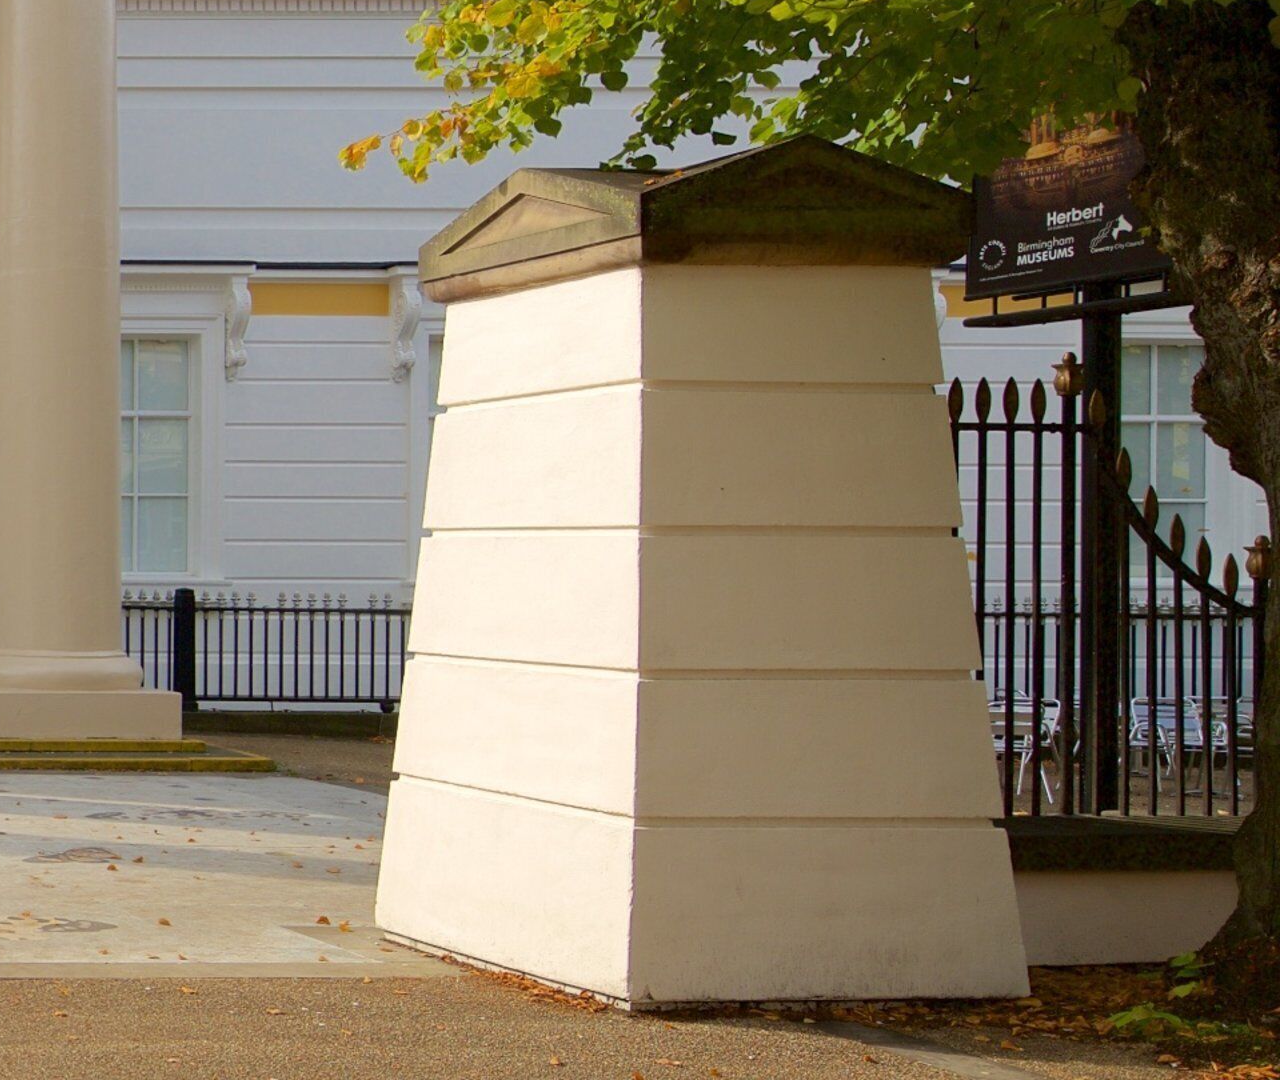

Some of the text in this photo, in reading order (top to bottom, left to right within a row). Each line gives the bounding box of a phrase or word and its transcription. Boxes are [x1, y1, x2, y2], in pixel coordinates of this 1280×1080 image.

[1047, 202, 1104, 227] Herbert
[1017, 236, 1075, 253] Birmingham
[1016, 246, 1075, 267] MUSEUMS
